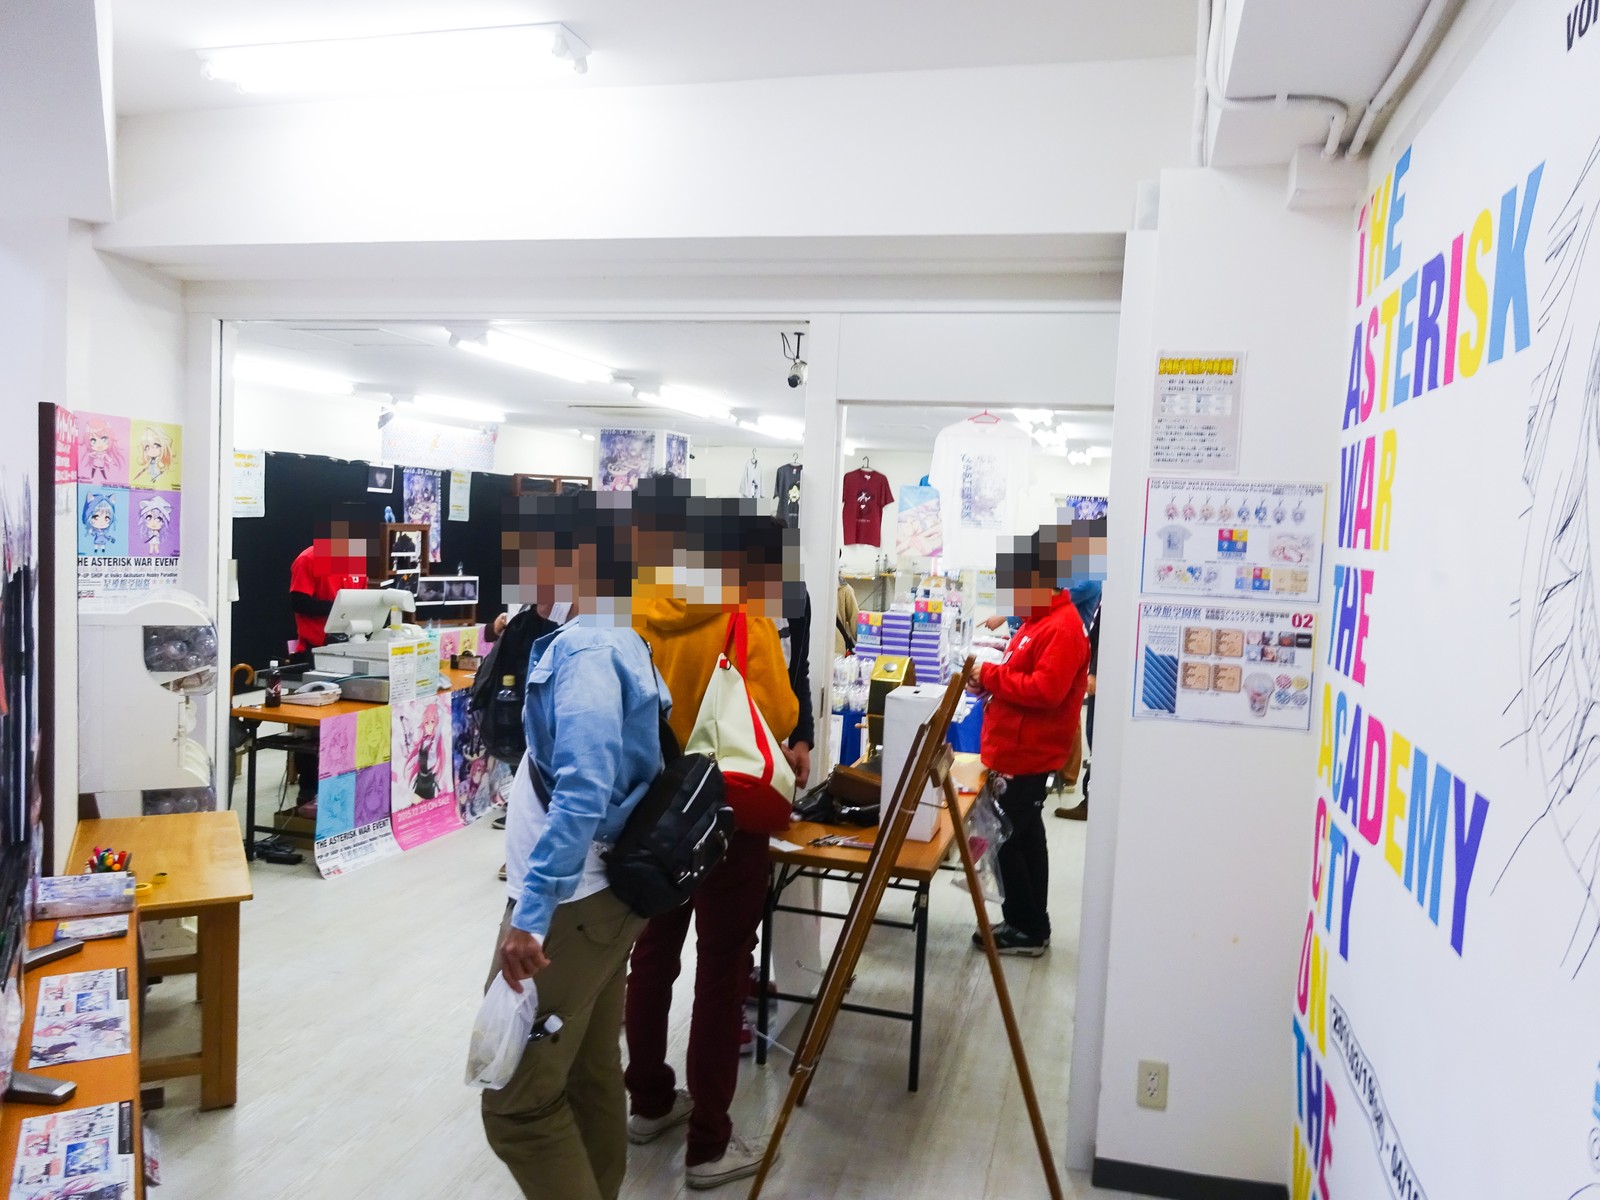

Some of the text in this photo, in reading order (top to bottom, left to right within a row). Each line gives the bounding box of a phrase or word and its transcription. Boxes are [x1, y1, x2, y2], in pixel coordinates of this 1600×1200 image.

[1342, 159, 1546, 430] ASTERISK
[1355, 144, 1412, 308] THE
[77, 557, 179, 567] HE ASTERISK WAR EVENT
[1338, 428, 1397, 552] WAR
[1291, 612, 1315, 629] 02
[1328, 564, 1375, 688] THE
[316, 839, 327, 850] THE
[329, 829, 357, 846] ASTERISK
[359, 824, 371, 835] WAR
[372, 818, 390, 831] EVENT
[1312, 797, 1361, 963] CITY
[1318, 682, 1490, 958] ACADEMY
[1298, 910, 1328, 1058] ON
[1293, 1014, 1337, 1200] THE
